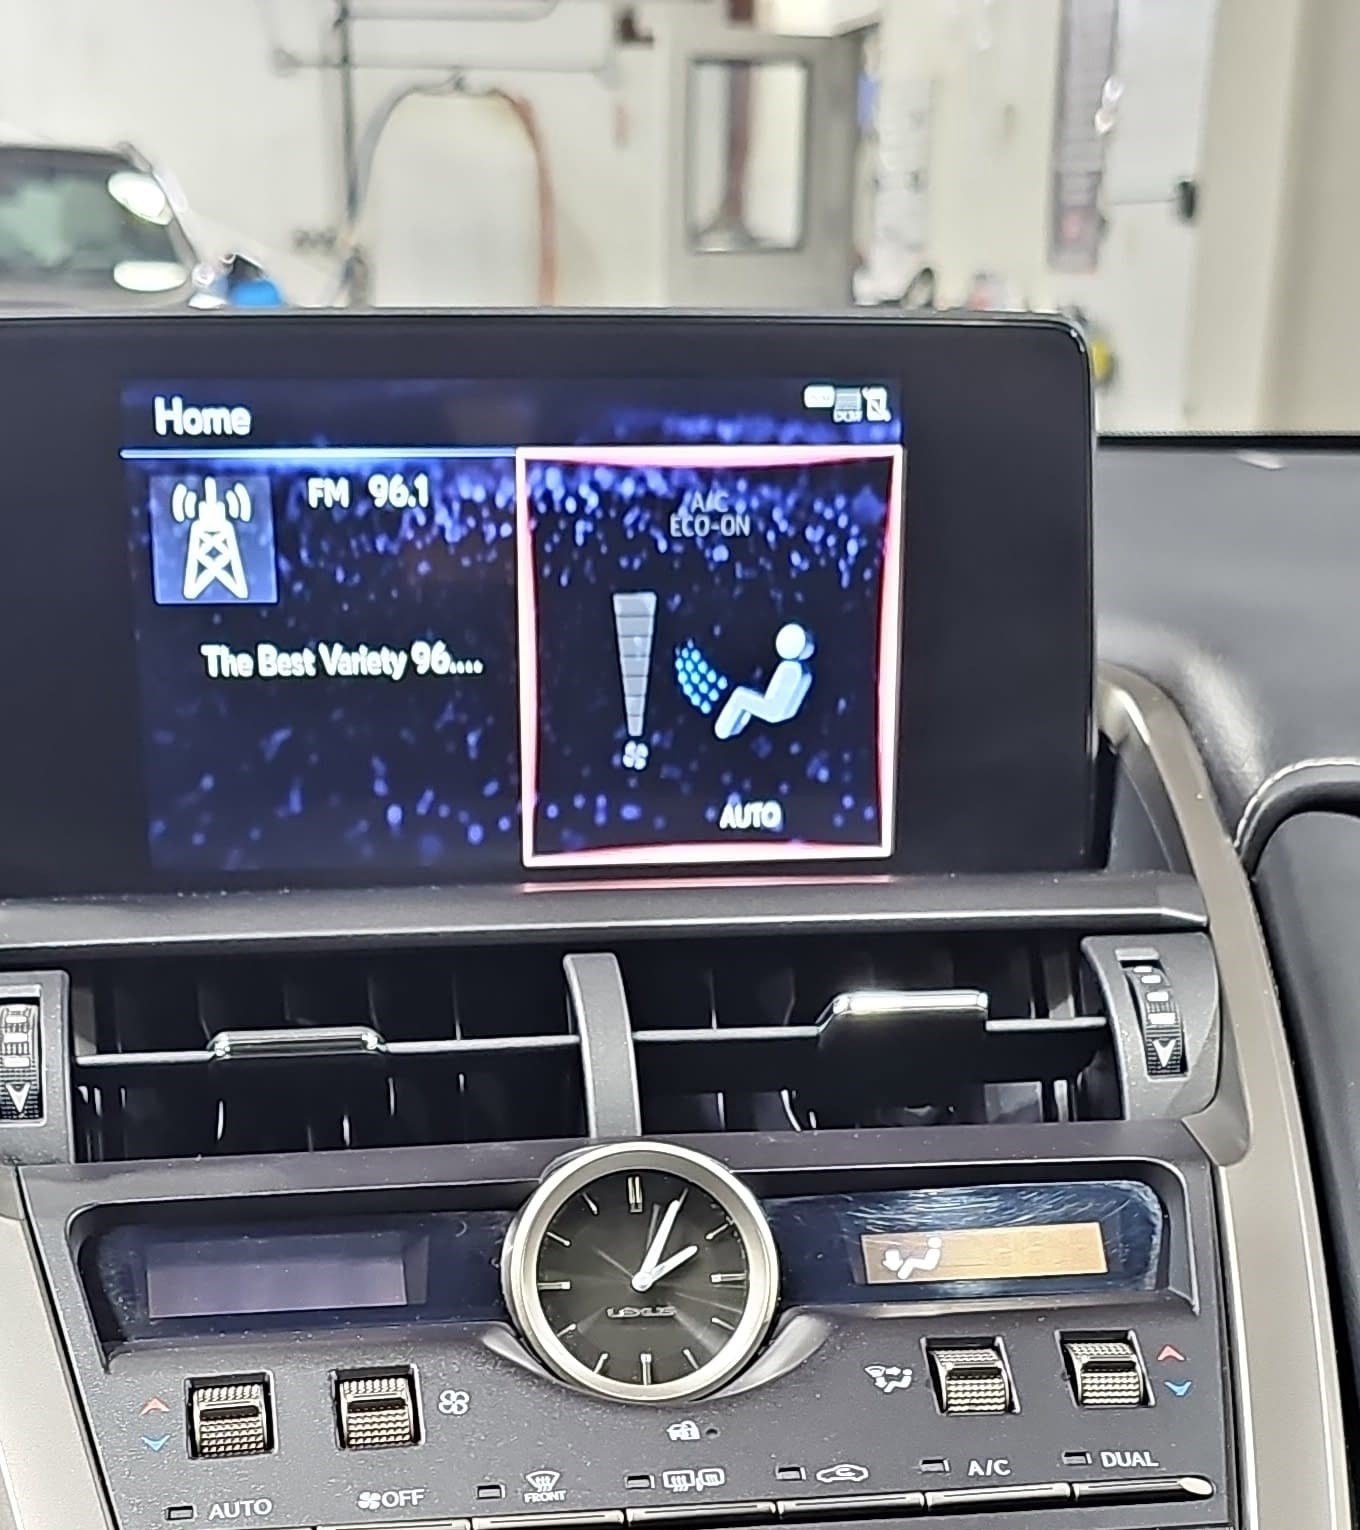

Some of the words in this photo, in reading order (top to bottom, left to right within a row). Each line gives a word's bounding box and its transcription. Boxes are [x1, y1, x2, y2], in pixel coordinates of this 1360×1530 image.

[153, 396, 252, 436] Home
[307, 477, 350, 508] FM
[367, 474, 429, 507] 96.1
[690, 490, 729, 514] A/C
[669, 514, 751, 537] ECO-ON
[200, 643, 254, 678] The
[256, 642, 316, 677] Best
[318, 643, 408, 680] Variety
[719, 801, 782, 830] AUTO
[967, 1456, 1012, 1479] A/C
[1099, 1450, 1159, 1469] DUAL
[208, 1498, 274, 1517] AUTO
[382, 1487, 425, 1508] OFF
[524, 1489, 567, 1503] FRONT
